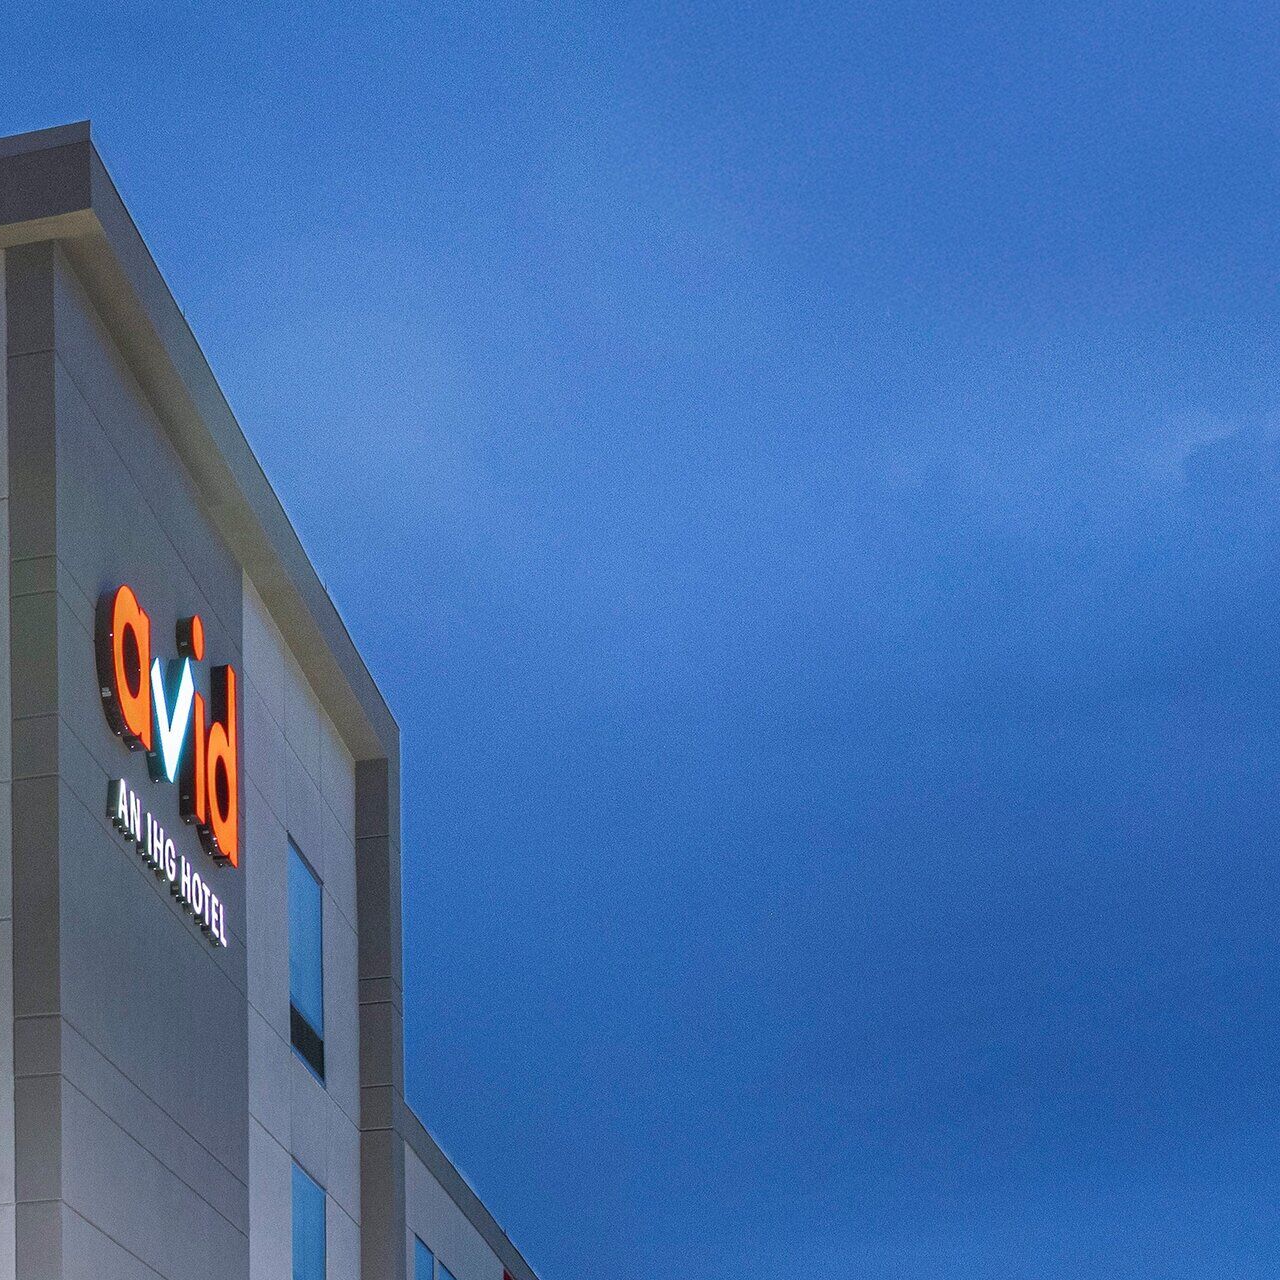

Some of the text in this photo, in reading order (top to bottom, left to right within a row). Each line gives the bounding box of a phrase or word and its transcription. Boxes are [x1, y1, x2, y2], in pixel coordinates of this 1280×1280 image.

[112, 584, 239, 869] avid
[117, 777, 228, 948] AN IHG HOTEL
